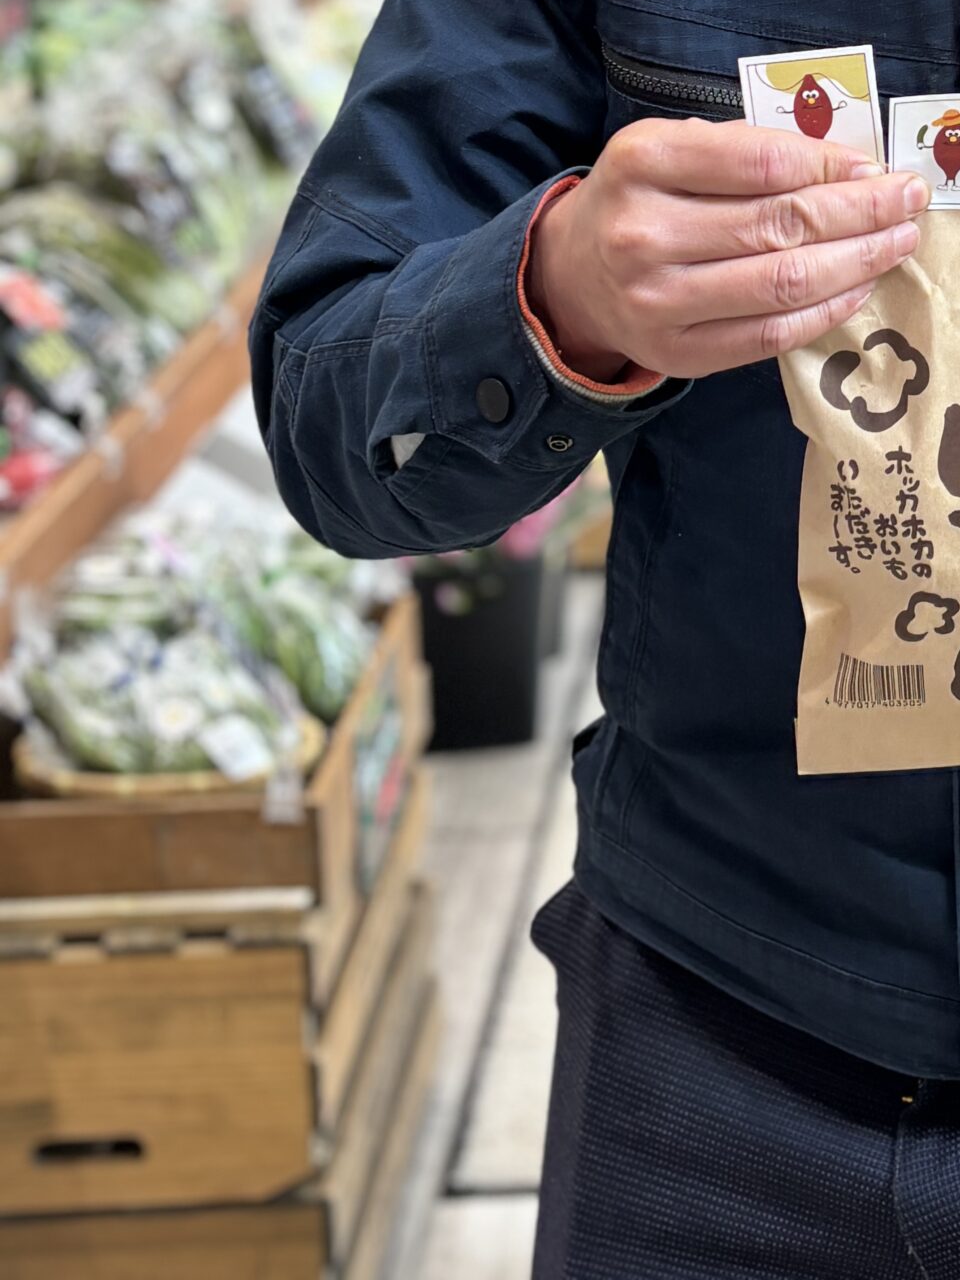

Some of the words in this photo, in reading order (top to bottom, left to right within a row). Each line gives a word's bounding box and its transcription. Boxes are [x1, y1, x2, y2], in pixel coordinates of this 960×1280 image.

[873, 513, 908, 580] おいも
[885, 445, 934, 578] ホッカホカの
